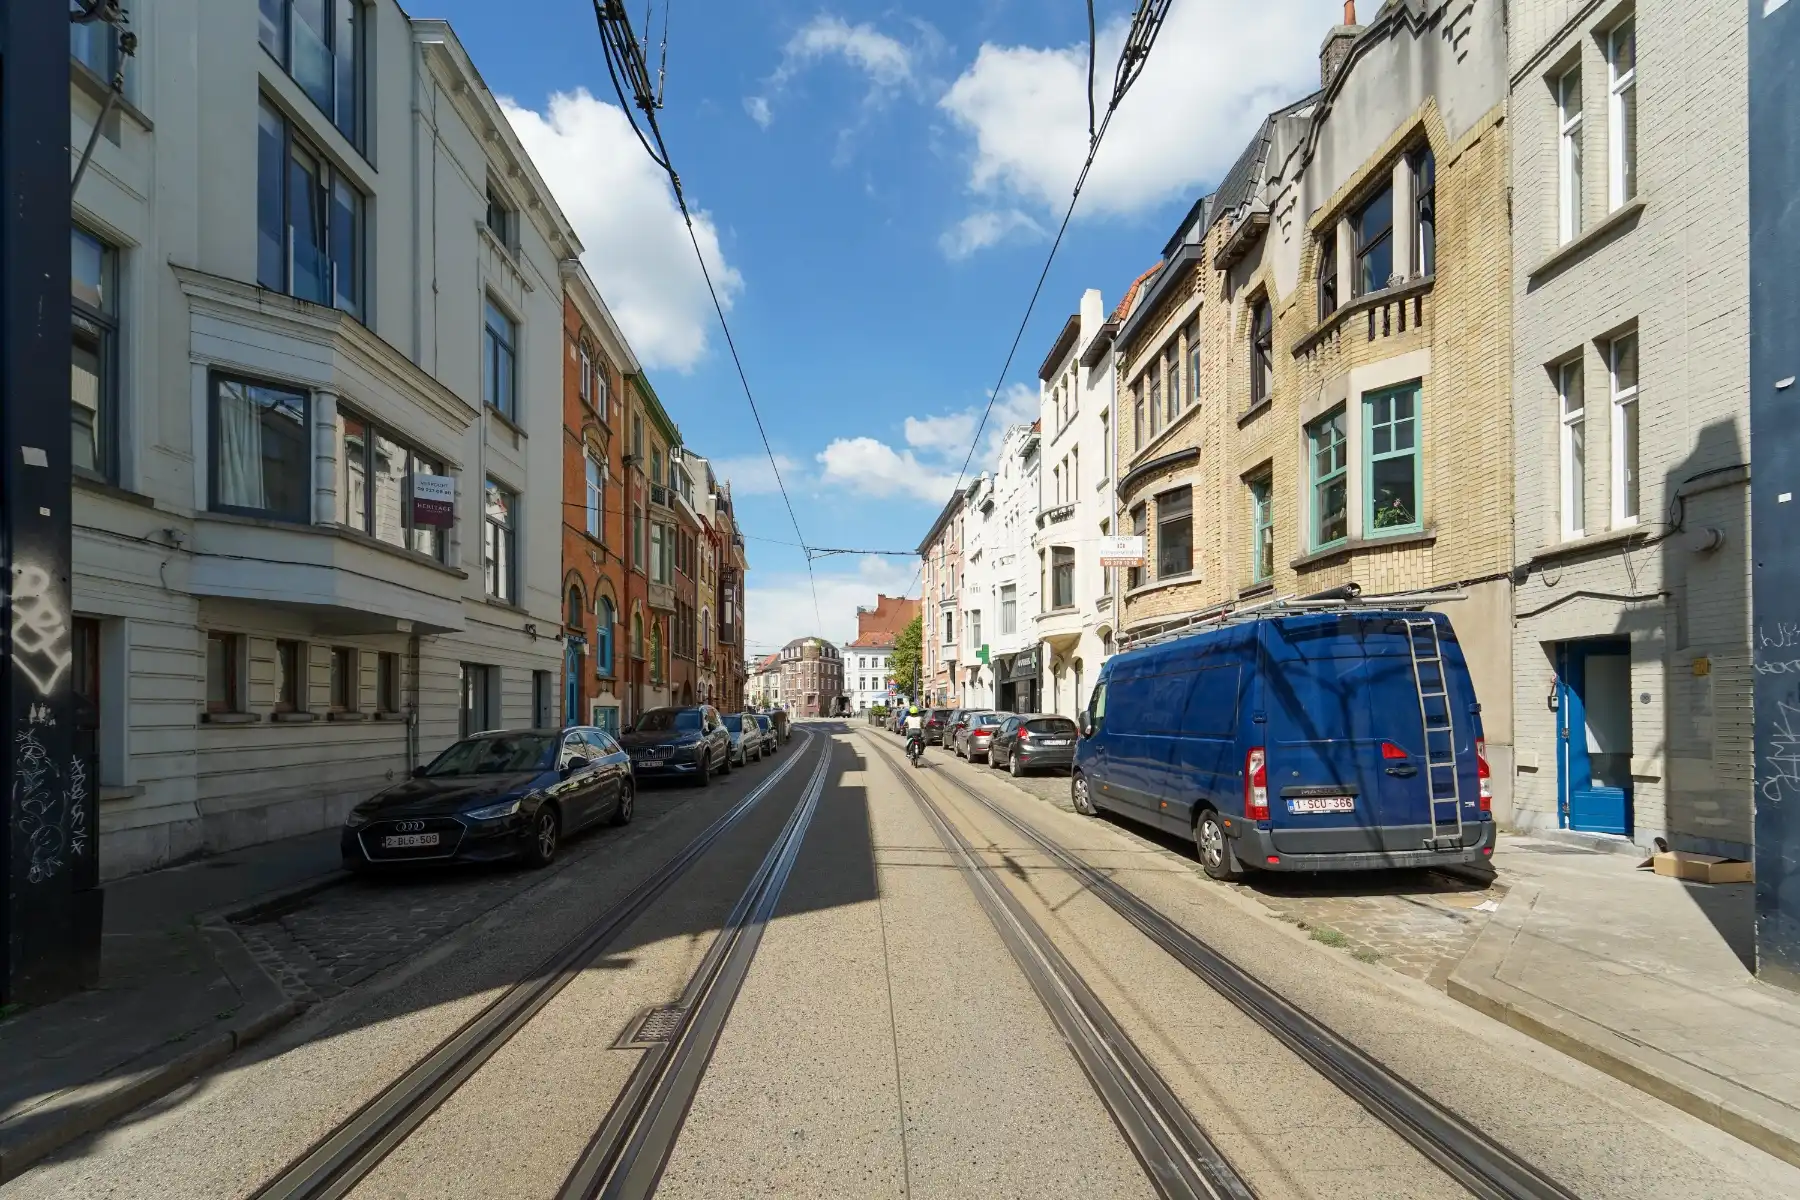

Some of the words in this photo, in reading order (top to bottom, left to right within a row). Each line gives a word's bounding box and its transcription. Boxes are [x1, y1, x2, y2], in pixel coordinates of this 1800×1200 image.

[417, 502, 451, 512] HERITAGE
[1296, 797, 1352, 809] 1-SCU-366
[386, 834, 438, 846] 2-BLG-509
